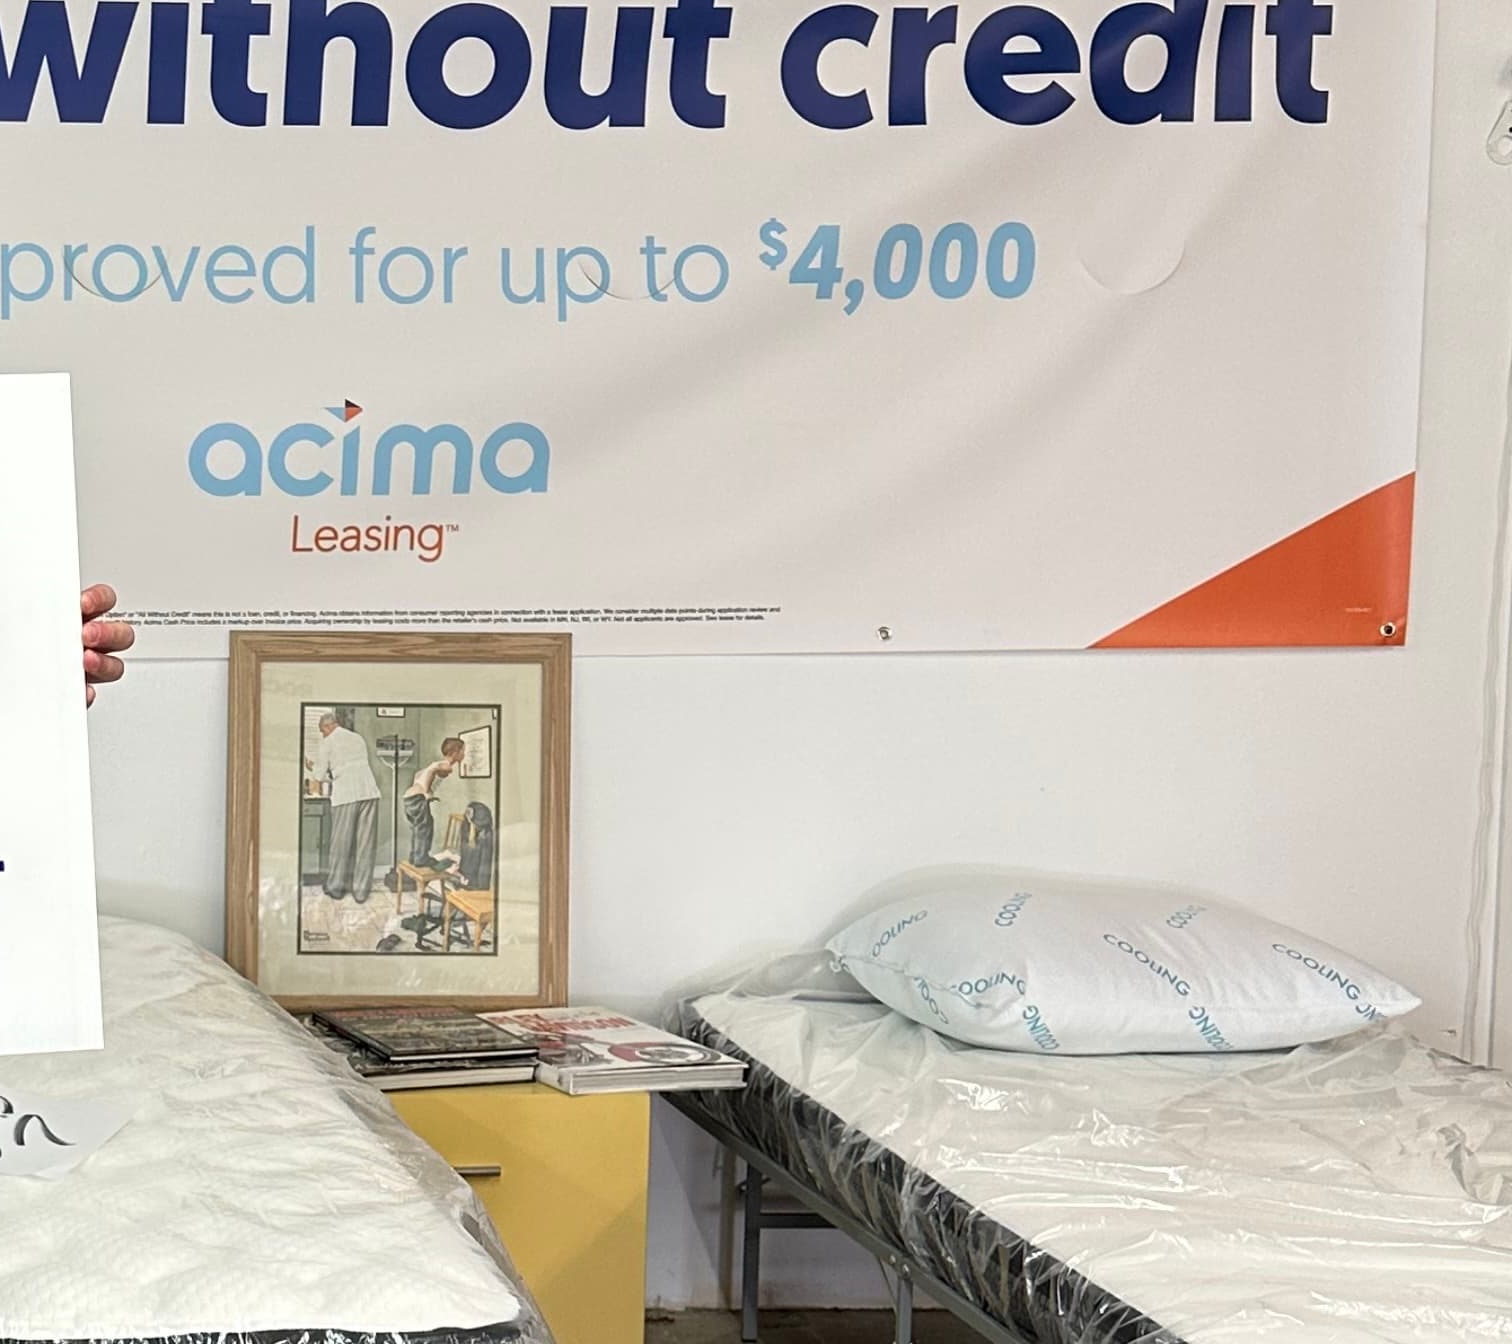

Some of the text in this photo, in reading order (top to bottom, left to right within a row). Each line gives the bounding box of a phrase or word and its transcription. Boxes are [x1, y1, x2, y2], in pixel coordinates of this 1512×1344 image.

[349, 227, 468, 304] for
[502, 247, 614, 321] up
[640, 236, 728, 302] to
[760, 218, 1035, 315] $4,000
[188, 398, 551, 497] acima
[1103, 934, 1191, 996] COOLING
[1272, 943, 1361, 1000] COOLING
